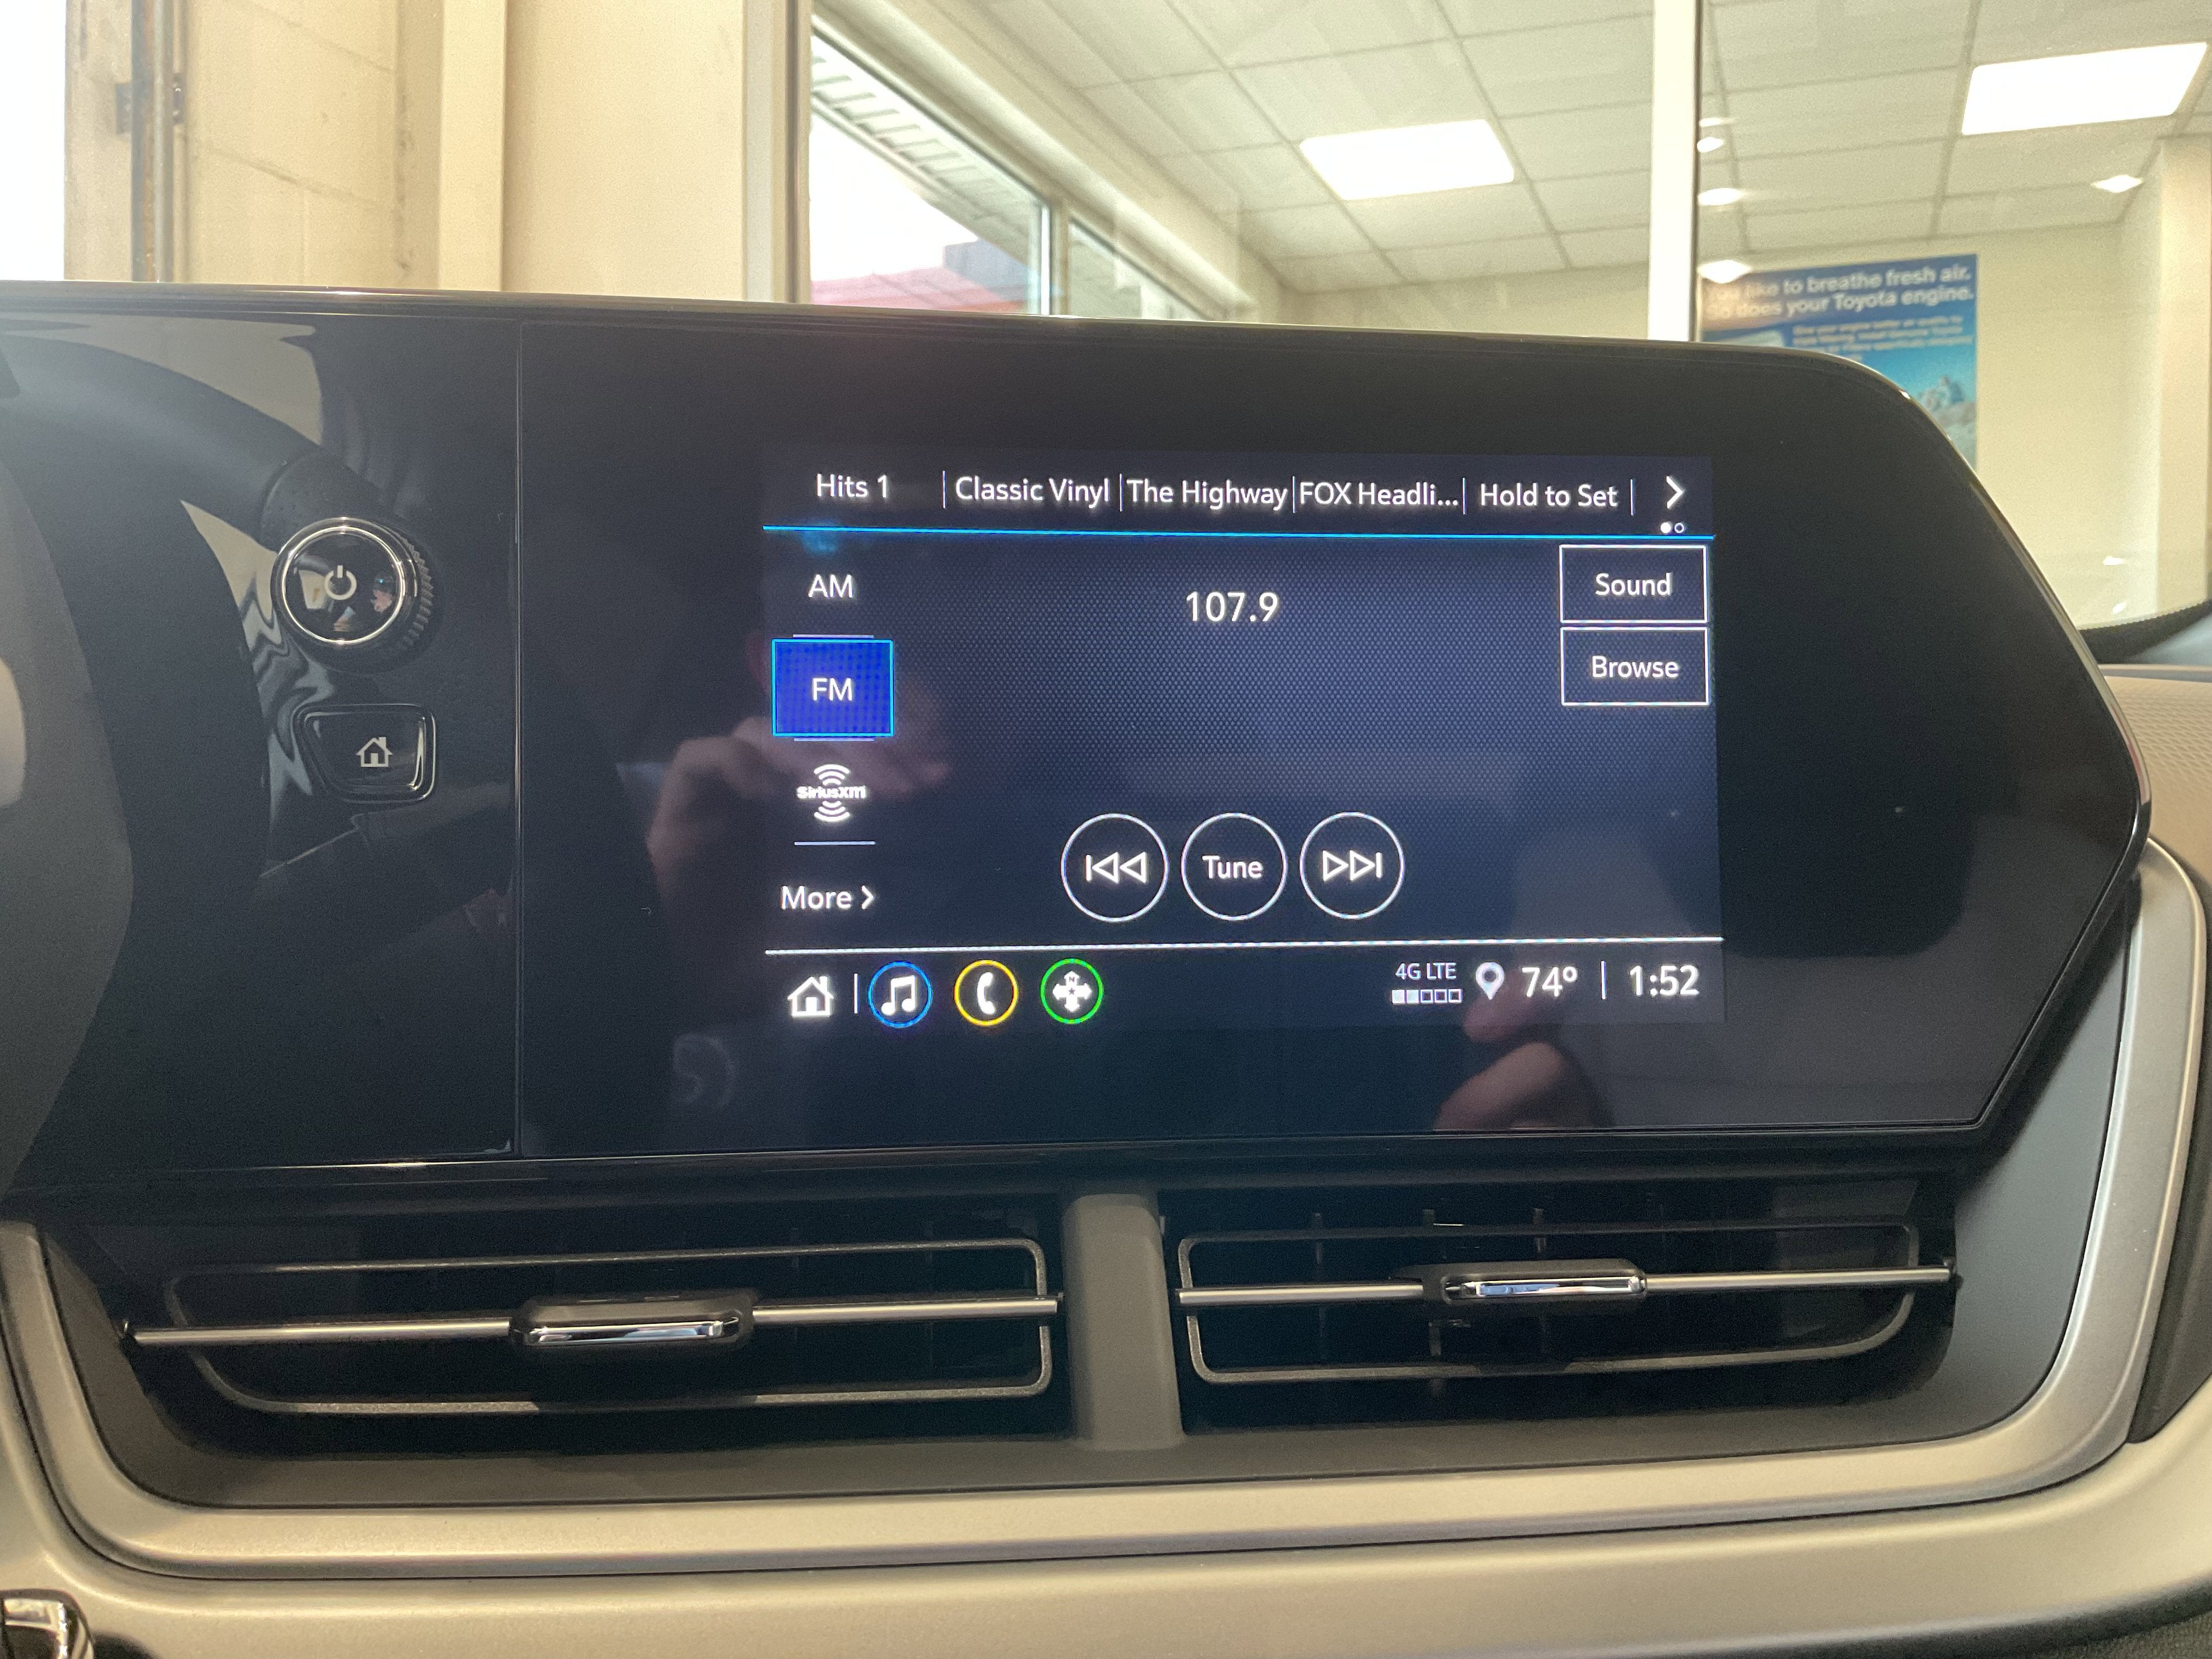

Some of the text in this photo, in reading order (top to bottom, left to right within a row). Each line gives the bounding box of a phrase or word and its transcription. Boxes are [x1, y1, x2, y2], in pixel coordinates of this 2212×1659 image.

[1784, 280, 1804, 295] to
[1807, 273, 1882, 292] breathe
[1886, 267, 1936, 287] fresh
[1940, 264, 1971, 283] air.
[1735, 302, 1782, 318] does
[1786, 296, 1830, 318] your
[1833, 290, 1897, 312] Toyota
[1901, 285, 1974, 307] engine.
[816, 473, 890, 500] Hits 1
[955, 475, 1110, 510] Classic Vinyl
[1125, 477, 1289, 512] The Highway
[1299, 481, 1459, 507] FOX Headli...
[1480, 482, 1619, 508] Hold to Set
[807, 573, 856, 600] AM
[1594, 571, 1673, 598] Sound
[1186, 590, 1280, 624] 107.9
[1591, 654, 1681, 680] Browse
[811, 676, 854, 702] FM
[1201, 854, 1264, 880] Tune
[780, 885, 854, 911] More
[1395, 962, 1457, 981] 4G LTE
[1629, 963, 1700, 998] 1:52
